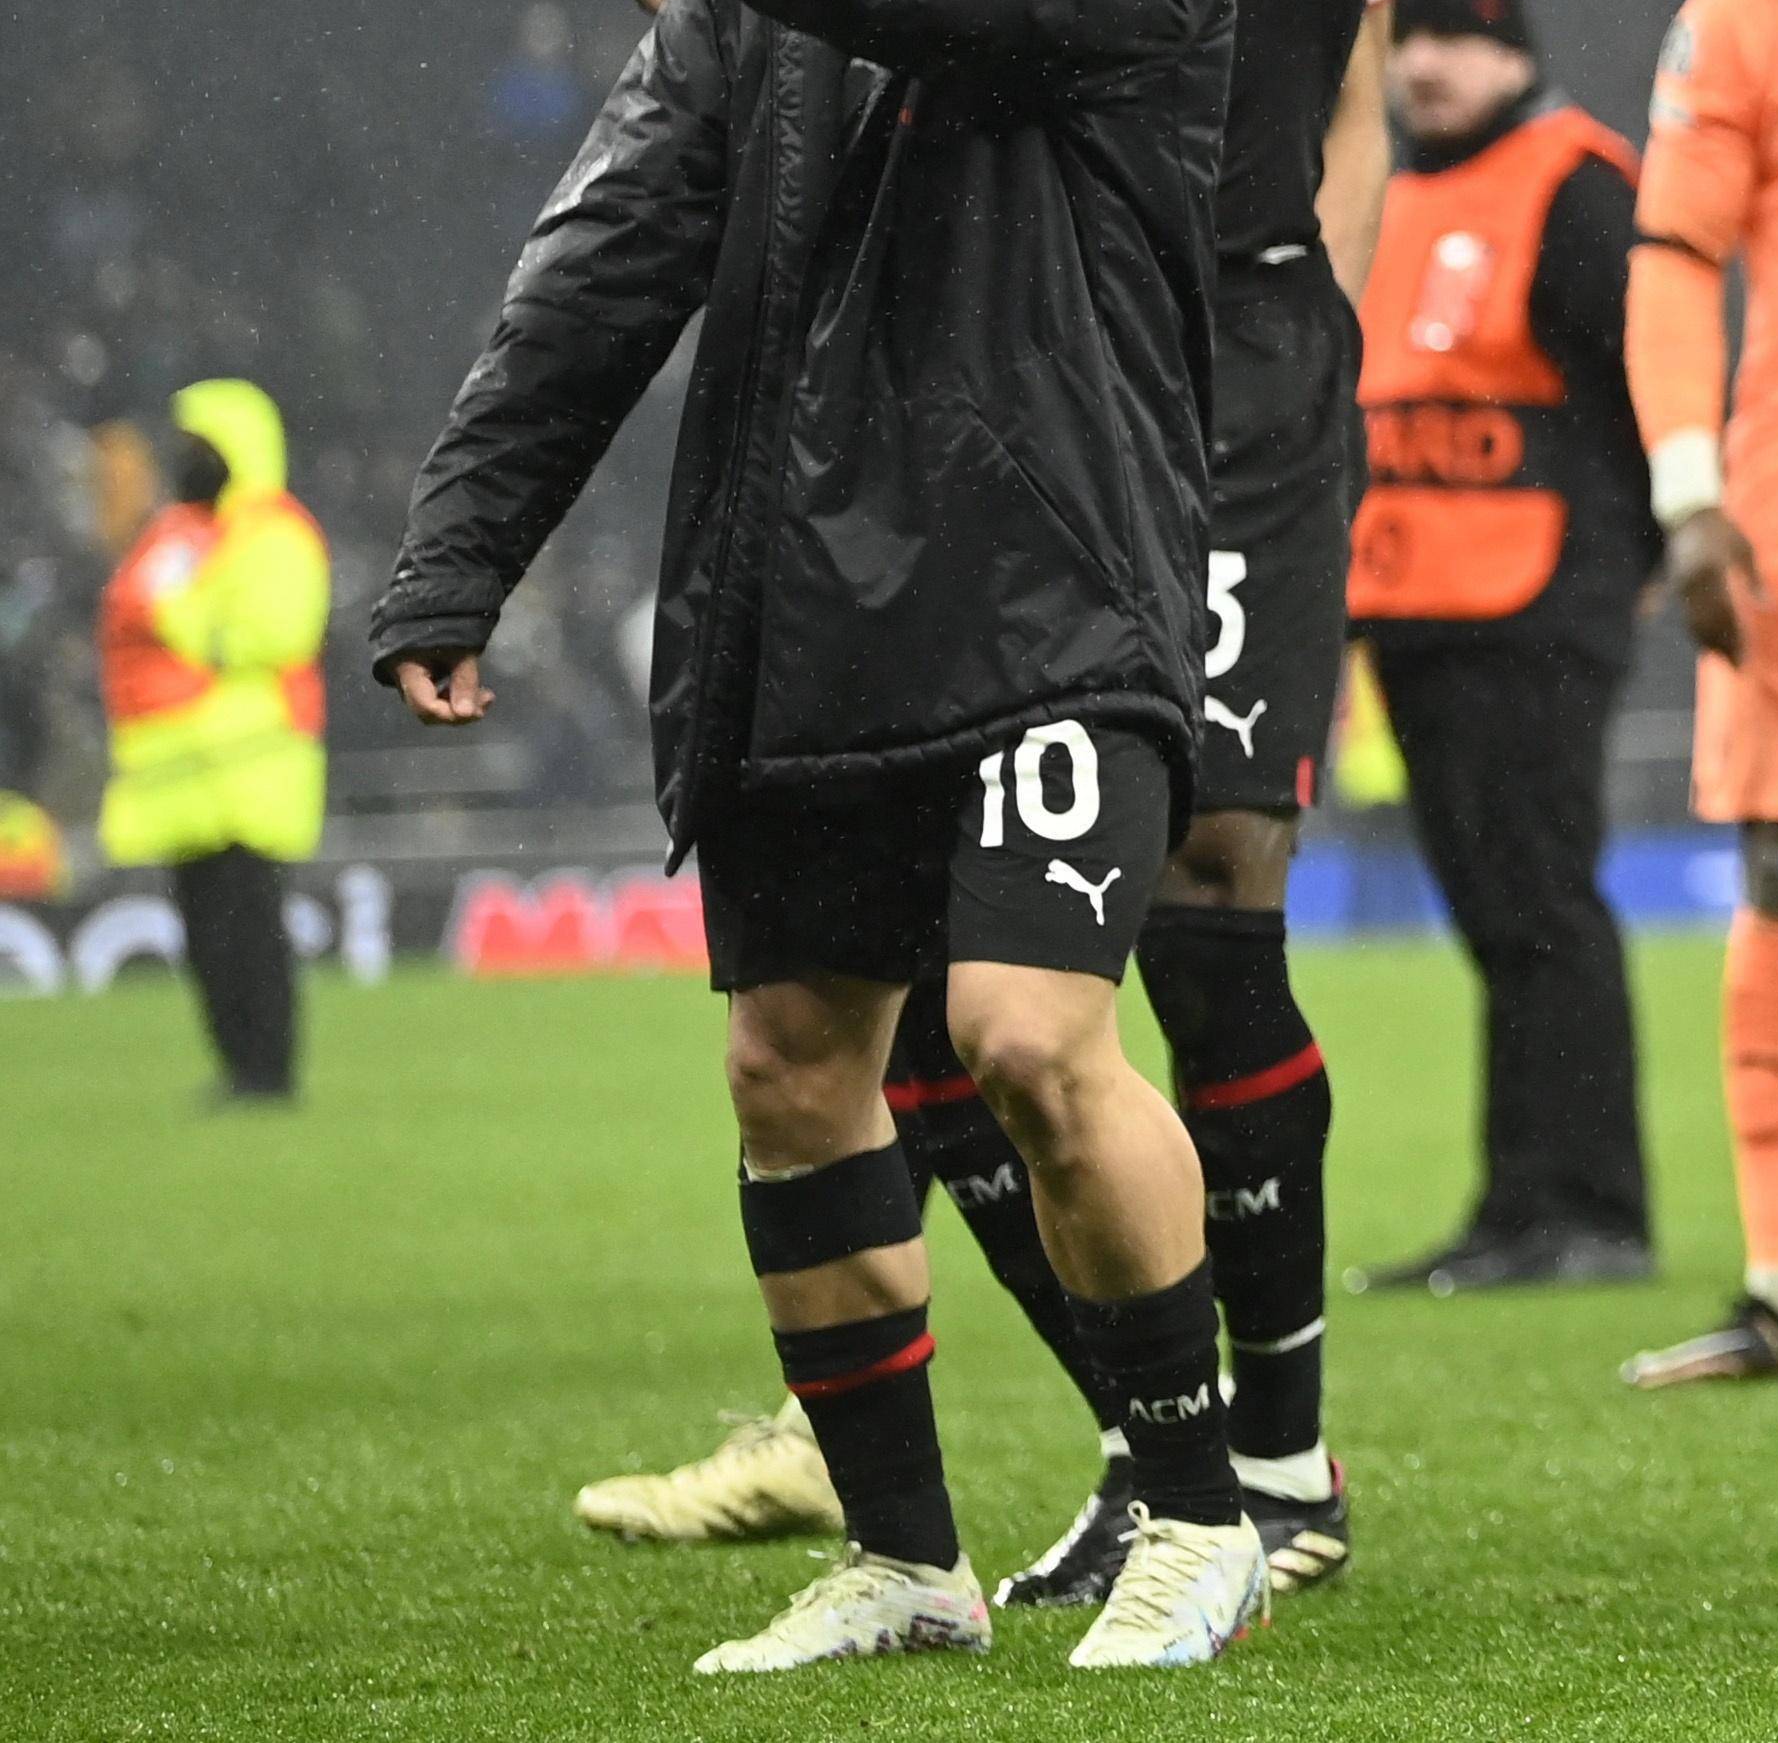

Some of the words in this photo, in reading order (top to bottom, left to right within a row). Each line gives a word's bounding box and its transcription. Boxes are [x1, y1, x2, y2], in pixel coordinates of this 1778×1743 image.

[979, 719, 1100, 848] 10
[1206, 1177, 1281, 1221] CM
[1129, 1382, 1210, 1424] ACM
